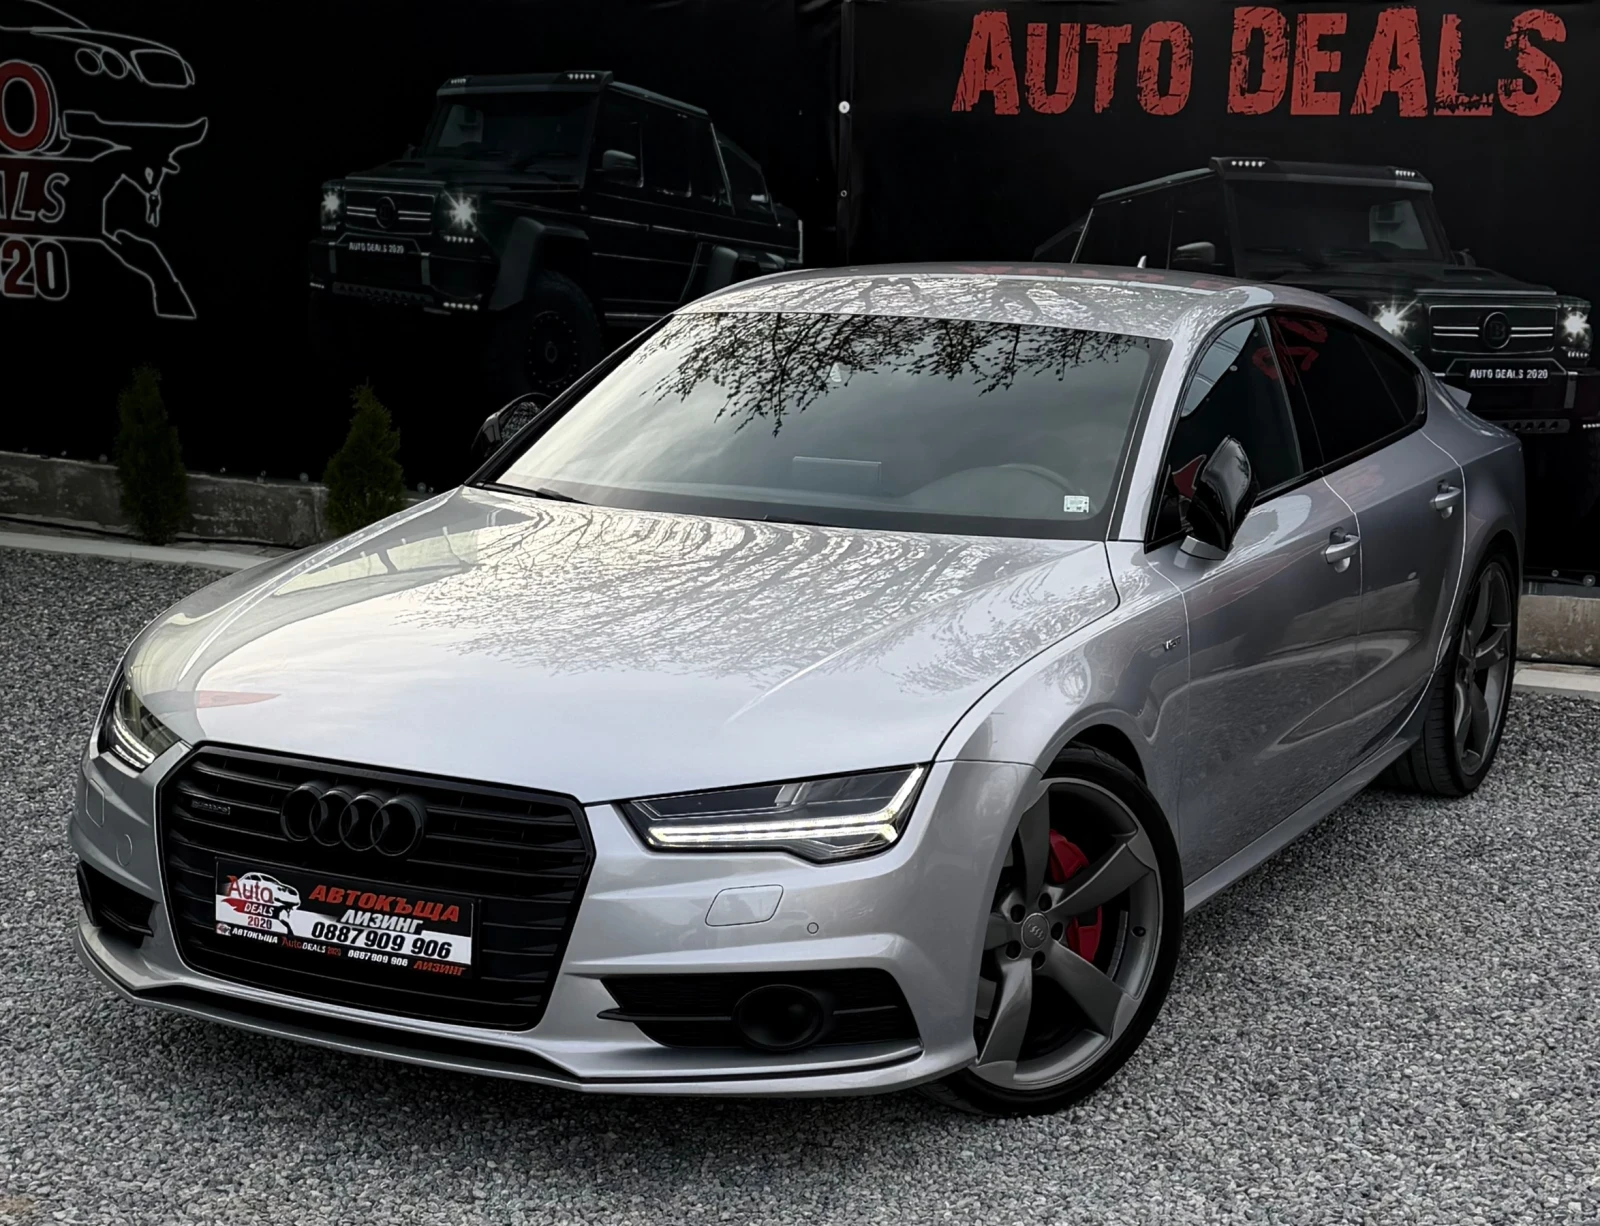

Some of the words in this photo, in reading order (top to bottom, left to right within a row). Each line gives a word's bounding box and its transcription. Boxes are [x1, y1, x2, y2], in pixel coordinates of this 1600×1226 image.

[951, 10, 1194, 115] AUTO
[1226, 6, 1568, 117] DEALS
[348, 242, 366, 252] AUTO
[367, 242, 387, 253] DEALS
[388, 244, 405, 254] 2020
[1469, 368, 1493, 379] AUTO
[1495, 368, 1524, 379] DEALS
[1526, 368, 1549, 379] 2020
[226, 875, 275, 904] Auto
[244, 902, 275, 917] DEALS
[308, 884, 460, 922] АВТОКЪЩА
[247, 915, 273, 930] 2020
[340, 909, 424, 934] ЛИЗИНГ
[410, 937, 453, 959] 906
[390, 956, 409, 967] 906
